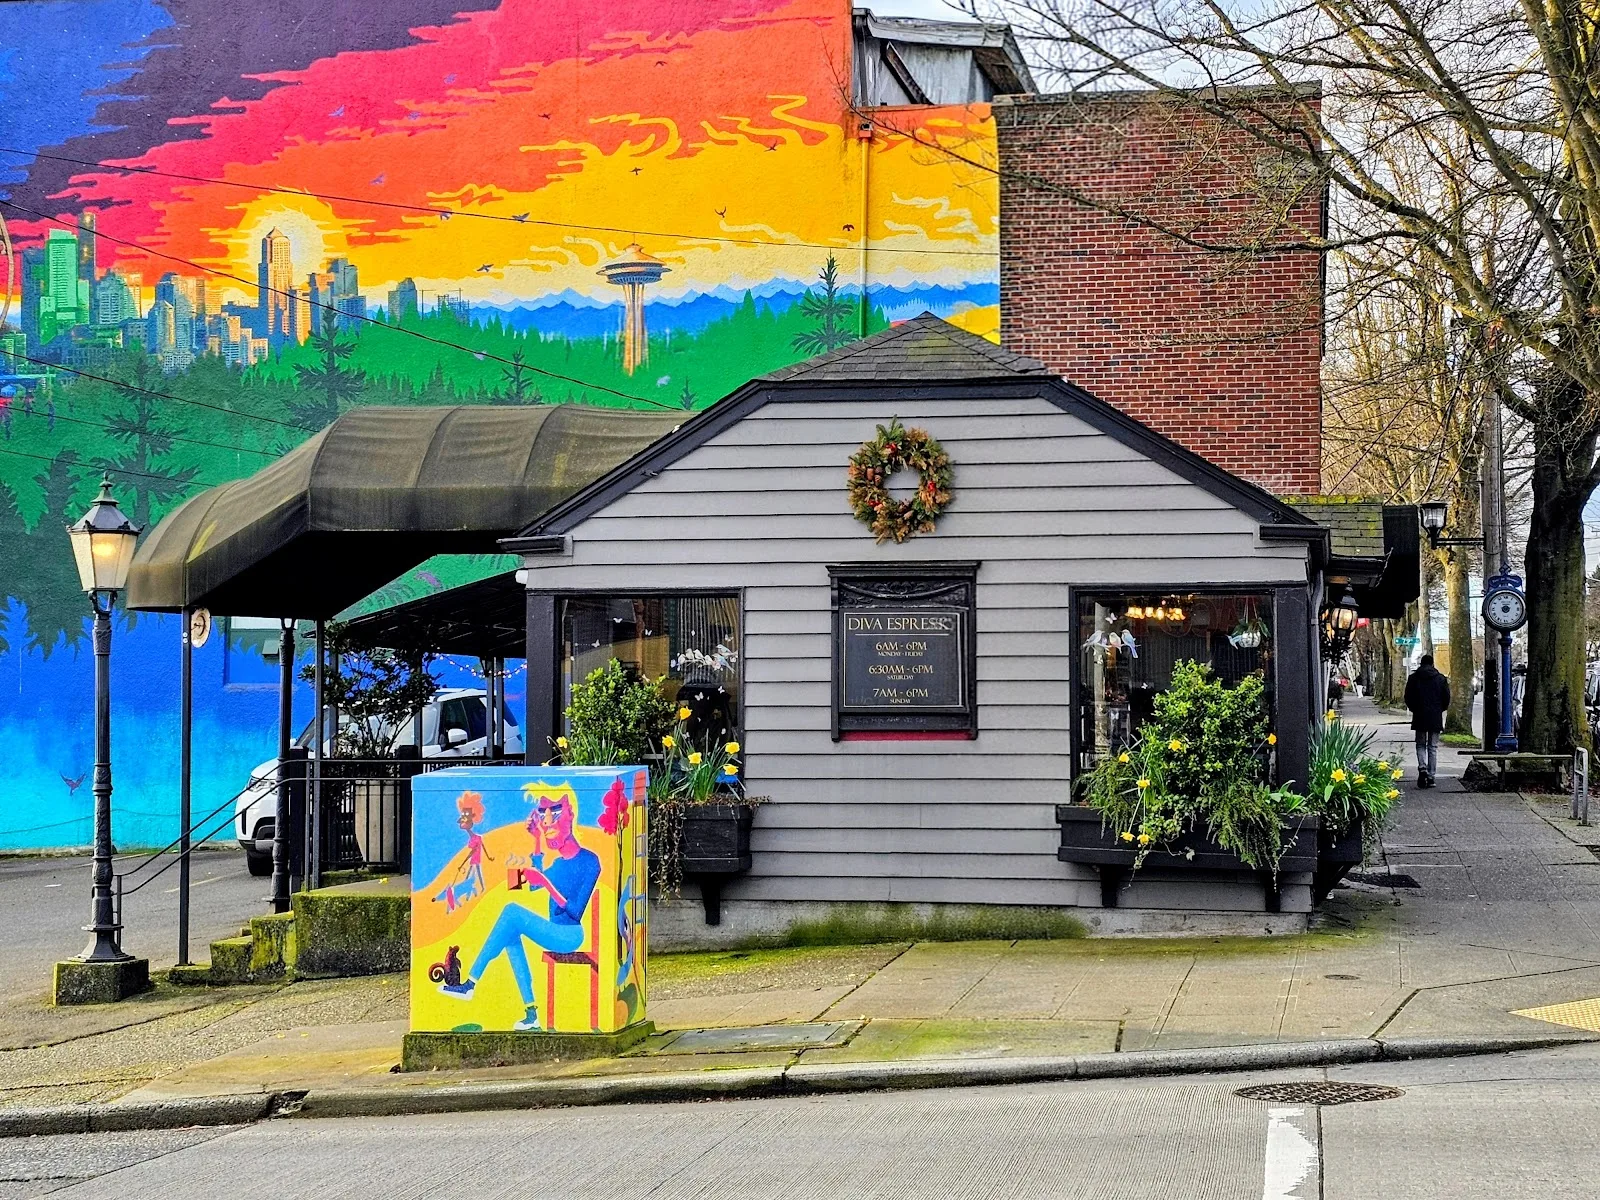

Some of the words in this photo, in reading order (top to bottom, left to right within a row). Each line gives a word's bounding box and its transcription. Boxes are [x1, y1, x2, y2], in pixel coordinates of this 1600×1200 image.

[848, 617, 882, 630] DIVA
[876, 642, 898, 651] 6AM
[906, 642, 927, 651] 6PM
[868, 665, 905, 674] 6:30AM
[912, 665, 933, 674] 6PM
[873, 688, 897, 698] 7AM
[906, 688, 928, 698] 6PM
